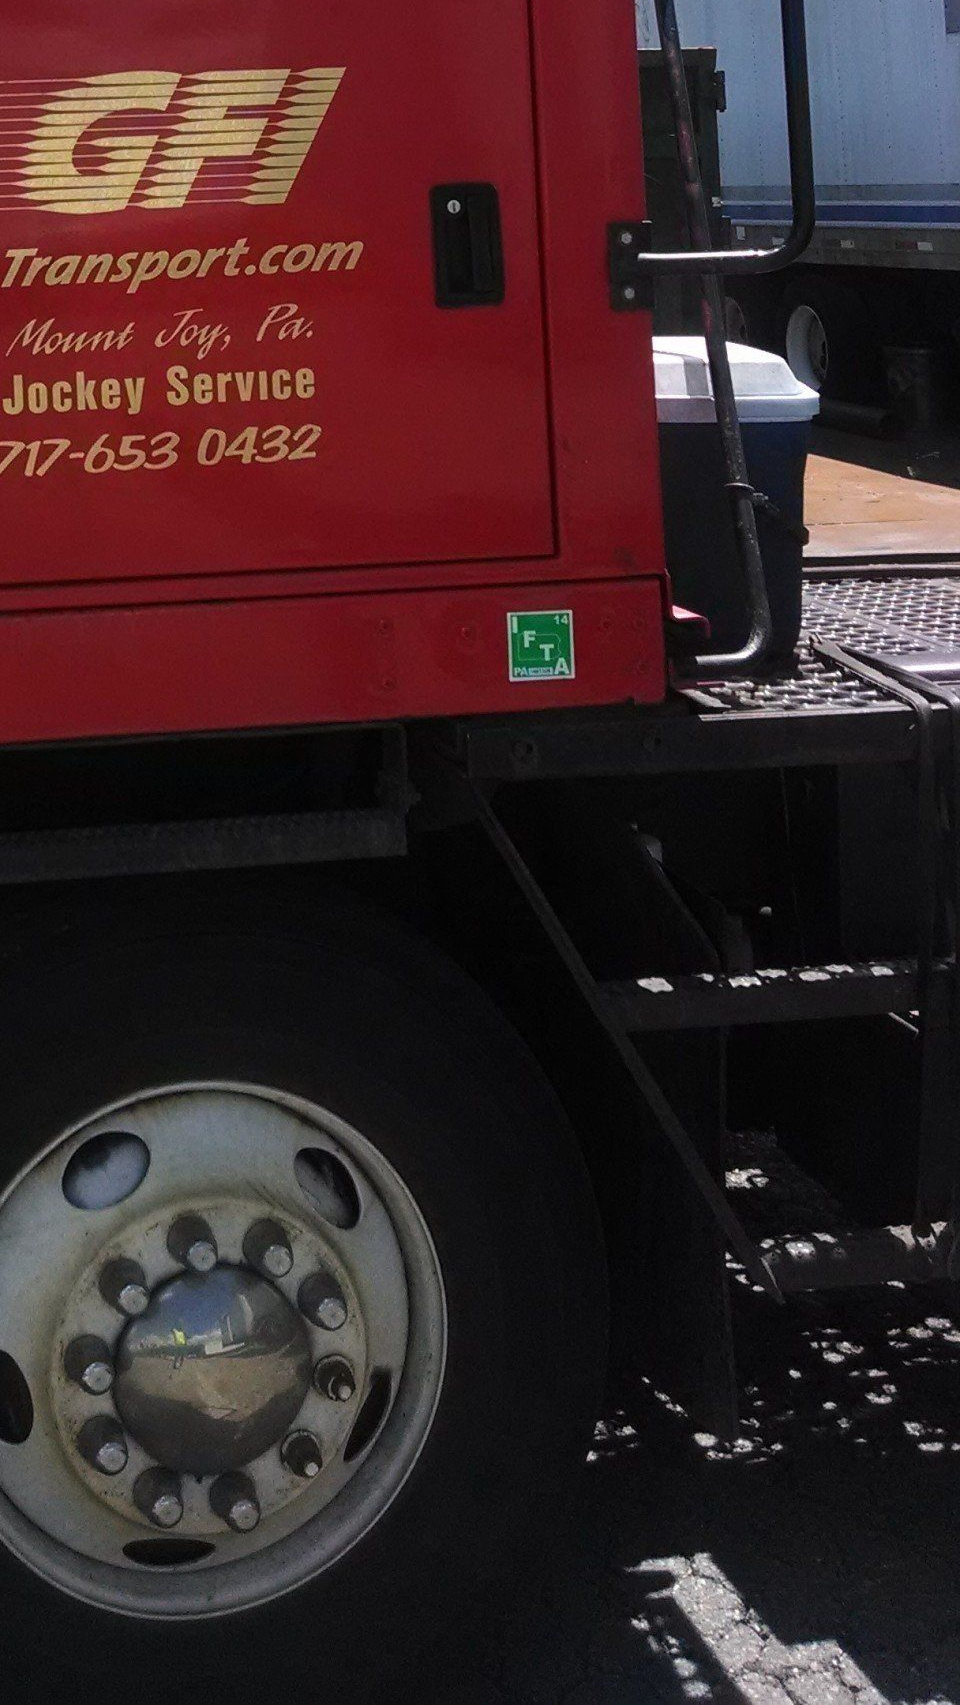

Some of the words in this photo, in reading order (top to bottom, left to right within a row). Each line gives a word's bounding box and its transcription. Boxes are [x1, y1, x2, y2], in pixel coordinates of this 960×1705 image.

[10, 67, 347, 215] GFI
[0, 237, 365, 294] Transport.com
[5, 317, 136, 357] Mount
[154, 308, 231, 360] Joy,
[256, 303, 314, 342] Pa.
[2, 371, 145, 415] Jockey
[166, 365, 316, 406] Service
[197, 423, 322, 465] 0432
[554, 615, 569, 625] 14
